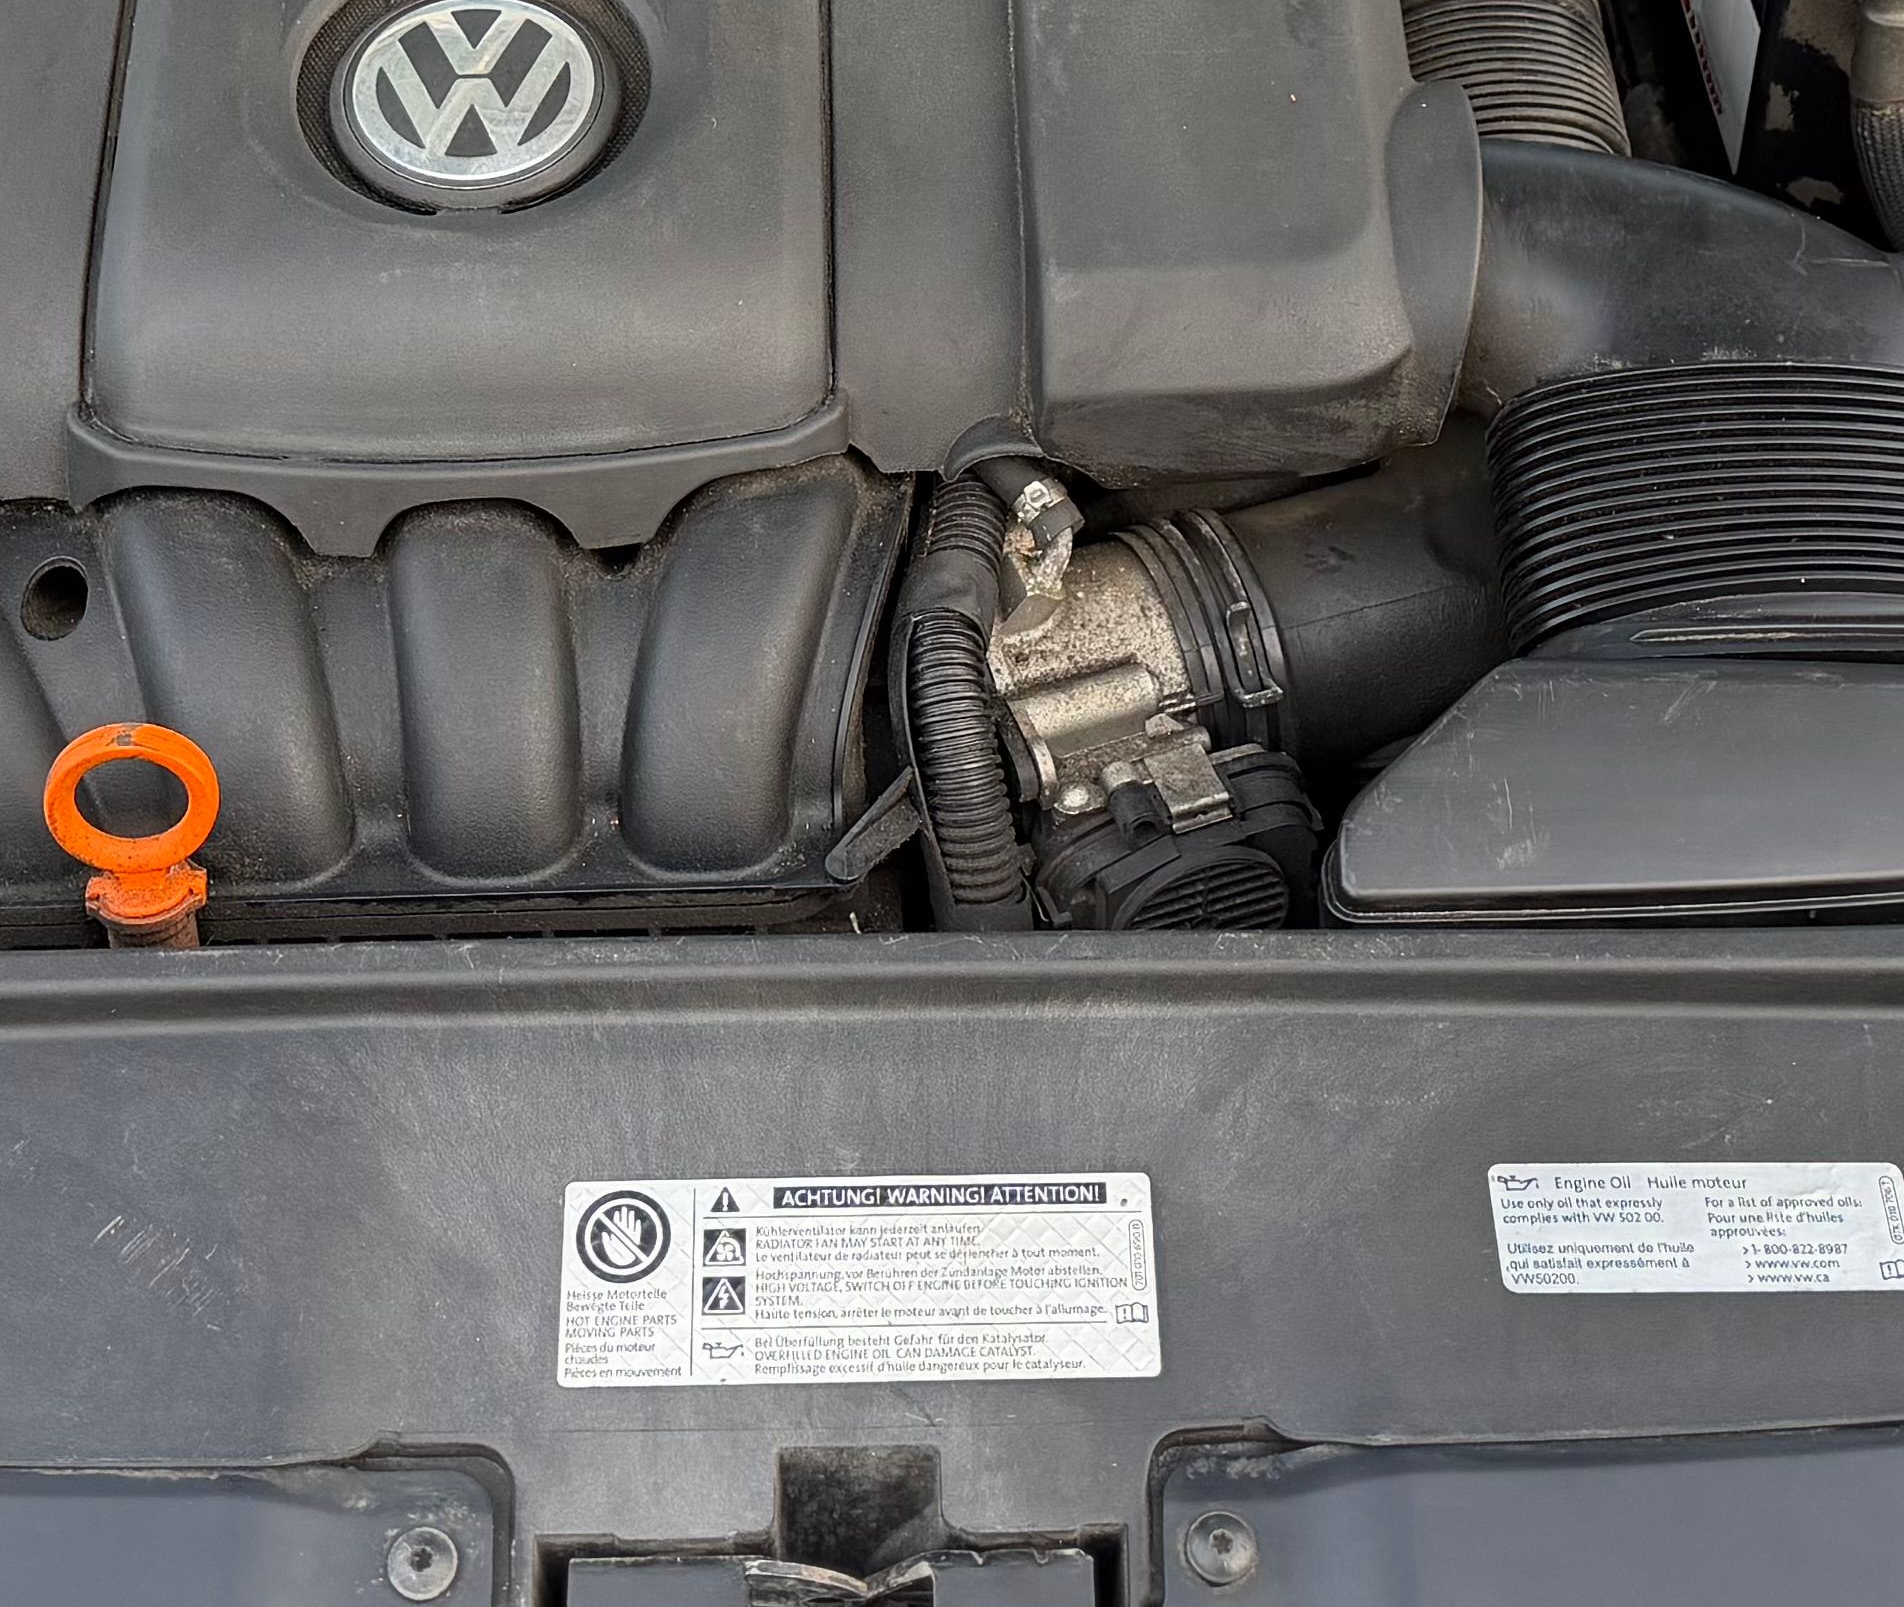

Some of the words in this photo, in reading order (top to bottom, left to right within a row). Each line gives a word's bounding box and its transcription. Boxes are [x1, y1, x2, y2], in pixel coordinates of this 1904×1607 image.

[366, 3, 584, 166] VW
[1554, 1176, 1606, 1193] Engine
[1610, 1176, 1632, 1189] Oil
[1647, 1176, 1687, 1189] Huile
[1692, 1176, 1747, 1190] moteur
[781, 1187, 881, 1207] ACHTUNG!
[886, 1186, 985, 1205] WARNING!
[990, 1185, 1100, 1203] ATTENTION!
[1500, 1198, 1524, 1209] Use
[1527, 1198, 1554, 1211] only
[1557, 1197, 1573, 1208] oil
[1575, 1197, 1601, 1208] that
[1605, 1196, 1662, 1210] expressly
[1704, 1197, 1724, 1208] For
[1728, 1199, 1735, 1208] a
[1737, 1196, 1756, 1208] list
[1759, 1196, 1773, 1207] of
[1776, 1196, 1834, 1209] approved
[1837, 1196, 1863, 1208] oils:
[1503, 1212, 1559, 1226] complies
[1561, 1212, 1590, 1223] with
[1593, 1212, 1615, 1223] VW
[1619, 1212, 1641, 1223] 502
[1645, 1212, 1664, 1223] 00.
[1707, 1212, 1736, 1224] Pour
[1739, 1213, 1763, 1223] une
[1766, 1212, 1793, 1223] liste
[1796, 1211, 1844, 1223] d'huiles
[849, 1224, 877, 1236] kann
[1710, 1227, 1786, 1239] approuvées:
[756, 1238, 813, 1250] RADIATOR
[815, 1237, 838, 1248] FAN
[841, 1236, 867, 1248] MAY
[870, 1236, 903, 1248] START
[905, 1236, 919, 1247] AT
[923, 1236, 946, 1247] ANY
[949, 1235, 981, 1247] TIME.
[1507, 1243, 1554, 1254] Utilisez
[1558, 1242, 1633, 1256] uniquement
[1637, 1242, 1654, 1254] de
[1657, 1242, 1695, 1254] l'huile
[771, 1249, 832, 1262] ventilateur
[834, 1249, 849, 1261] de
[851, 1249, 903, 1261] radiateur
[906, 1248, 931, 1263] peut
[934, 1249, 946, 1259] se
[1021, 1247, 1045, 1258] tout
[1048, 1247, 1100, 1258] moment.
[1509, 1257, 1529, 1271] qui
[1533, 1257, 1583, 1270] satisfait
[1586, 1256, 1678, 1271] expressément
[1681, 1256, 1690, 1268] à
[1754, 1259, 1841, 1269] www.vw.com
[845, 1270, 863, 1279] vor
[920, 1267, 939, 1278] der
[1010, 1266, 1046, 1276] Motor
[1757, 1274, 1830, 1284] www.vw.ca
[755, 1282, 786, 1293] HIGH
[788, 1281, 843, 1294] VOLTAGE,
[845, 1281, 890, 1292] SWITCH
[893, 1281, 914, 1291] OFF
[917, 1280, 961, 1291] ENGINE
[964, 1278, 1007, 1290] BEFORE
[1009, 1277, 1072, 1289] TOUCHING
[1074, 1277, 1128, 1288] IGNITION
[567, 1290, 604, 1301] Heisse
[607, 1288, 667, 1300] Motorteile
[755, 1295, 803, 1306] SYSTEM.
[566, 1300, 617, 1314] Bewegte
[619, 1300, 645, 1311] Teile
[755, 1309, 790, 1320] Haute
[841, 1307, 879, 1318] arrêter
[881, 1307, 891, 1317] le
[894, 1307, 936, 1318] moteur
[939, 1305, 970, 1317] avant
[973, 1305, 987, 1316] de
[990, 1304, 1033, 1316] toucher
[566, 1316, 590, 1327] HOT
[594, 1315, 641, 1327] ENGINE
[643, 1314, 677, 1326] PARTS
[565, 1327, 616, 1338] MOVING
[620, 1326, 655, 1337] PARTS
[599, 1341, 614, 1353] du
[616, 1342, 655, 1352] moteur
[755, 1336, 772, 1348] Bei
[848, 1335, 890, 1346] besteht
[894, 1334, 933, 1345] Gefahr
[938, 1334, 955, 1345] für
[957, 1333, 979, 1344] den
[565, 1353, 608, 1364] chaudes
[755, 1349, 822, 1361] OVERFILLED
[826, 1349, 869, 1360] ENGINE
[872, 1348, 890, 1359] OIL
[896, 1348, 922, 1359] CAN
[924, 1346, 976, 1358] DAMAGE
[979, 1345, 1036, 1357] CATALYST.
[599, 1369, 613, 1378] en
[616, 1366, 682, 1377] mouvement
[755, 1363, 826, 1377] Remplissage
[828, 1362, 874, 1374] excessif
[877, 1361, 916, 1373] d'huile
[918, 1360, 979, 1374] dangereux
[983, 1360, 1009, 1372] pour
[1012, 1359, 1022, 1370] le
[1025, 1358, 1086, 1372] catalyseur.
